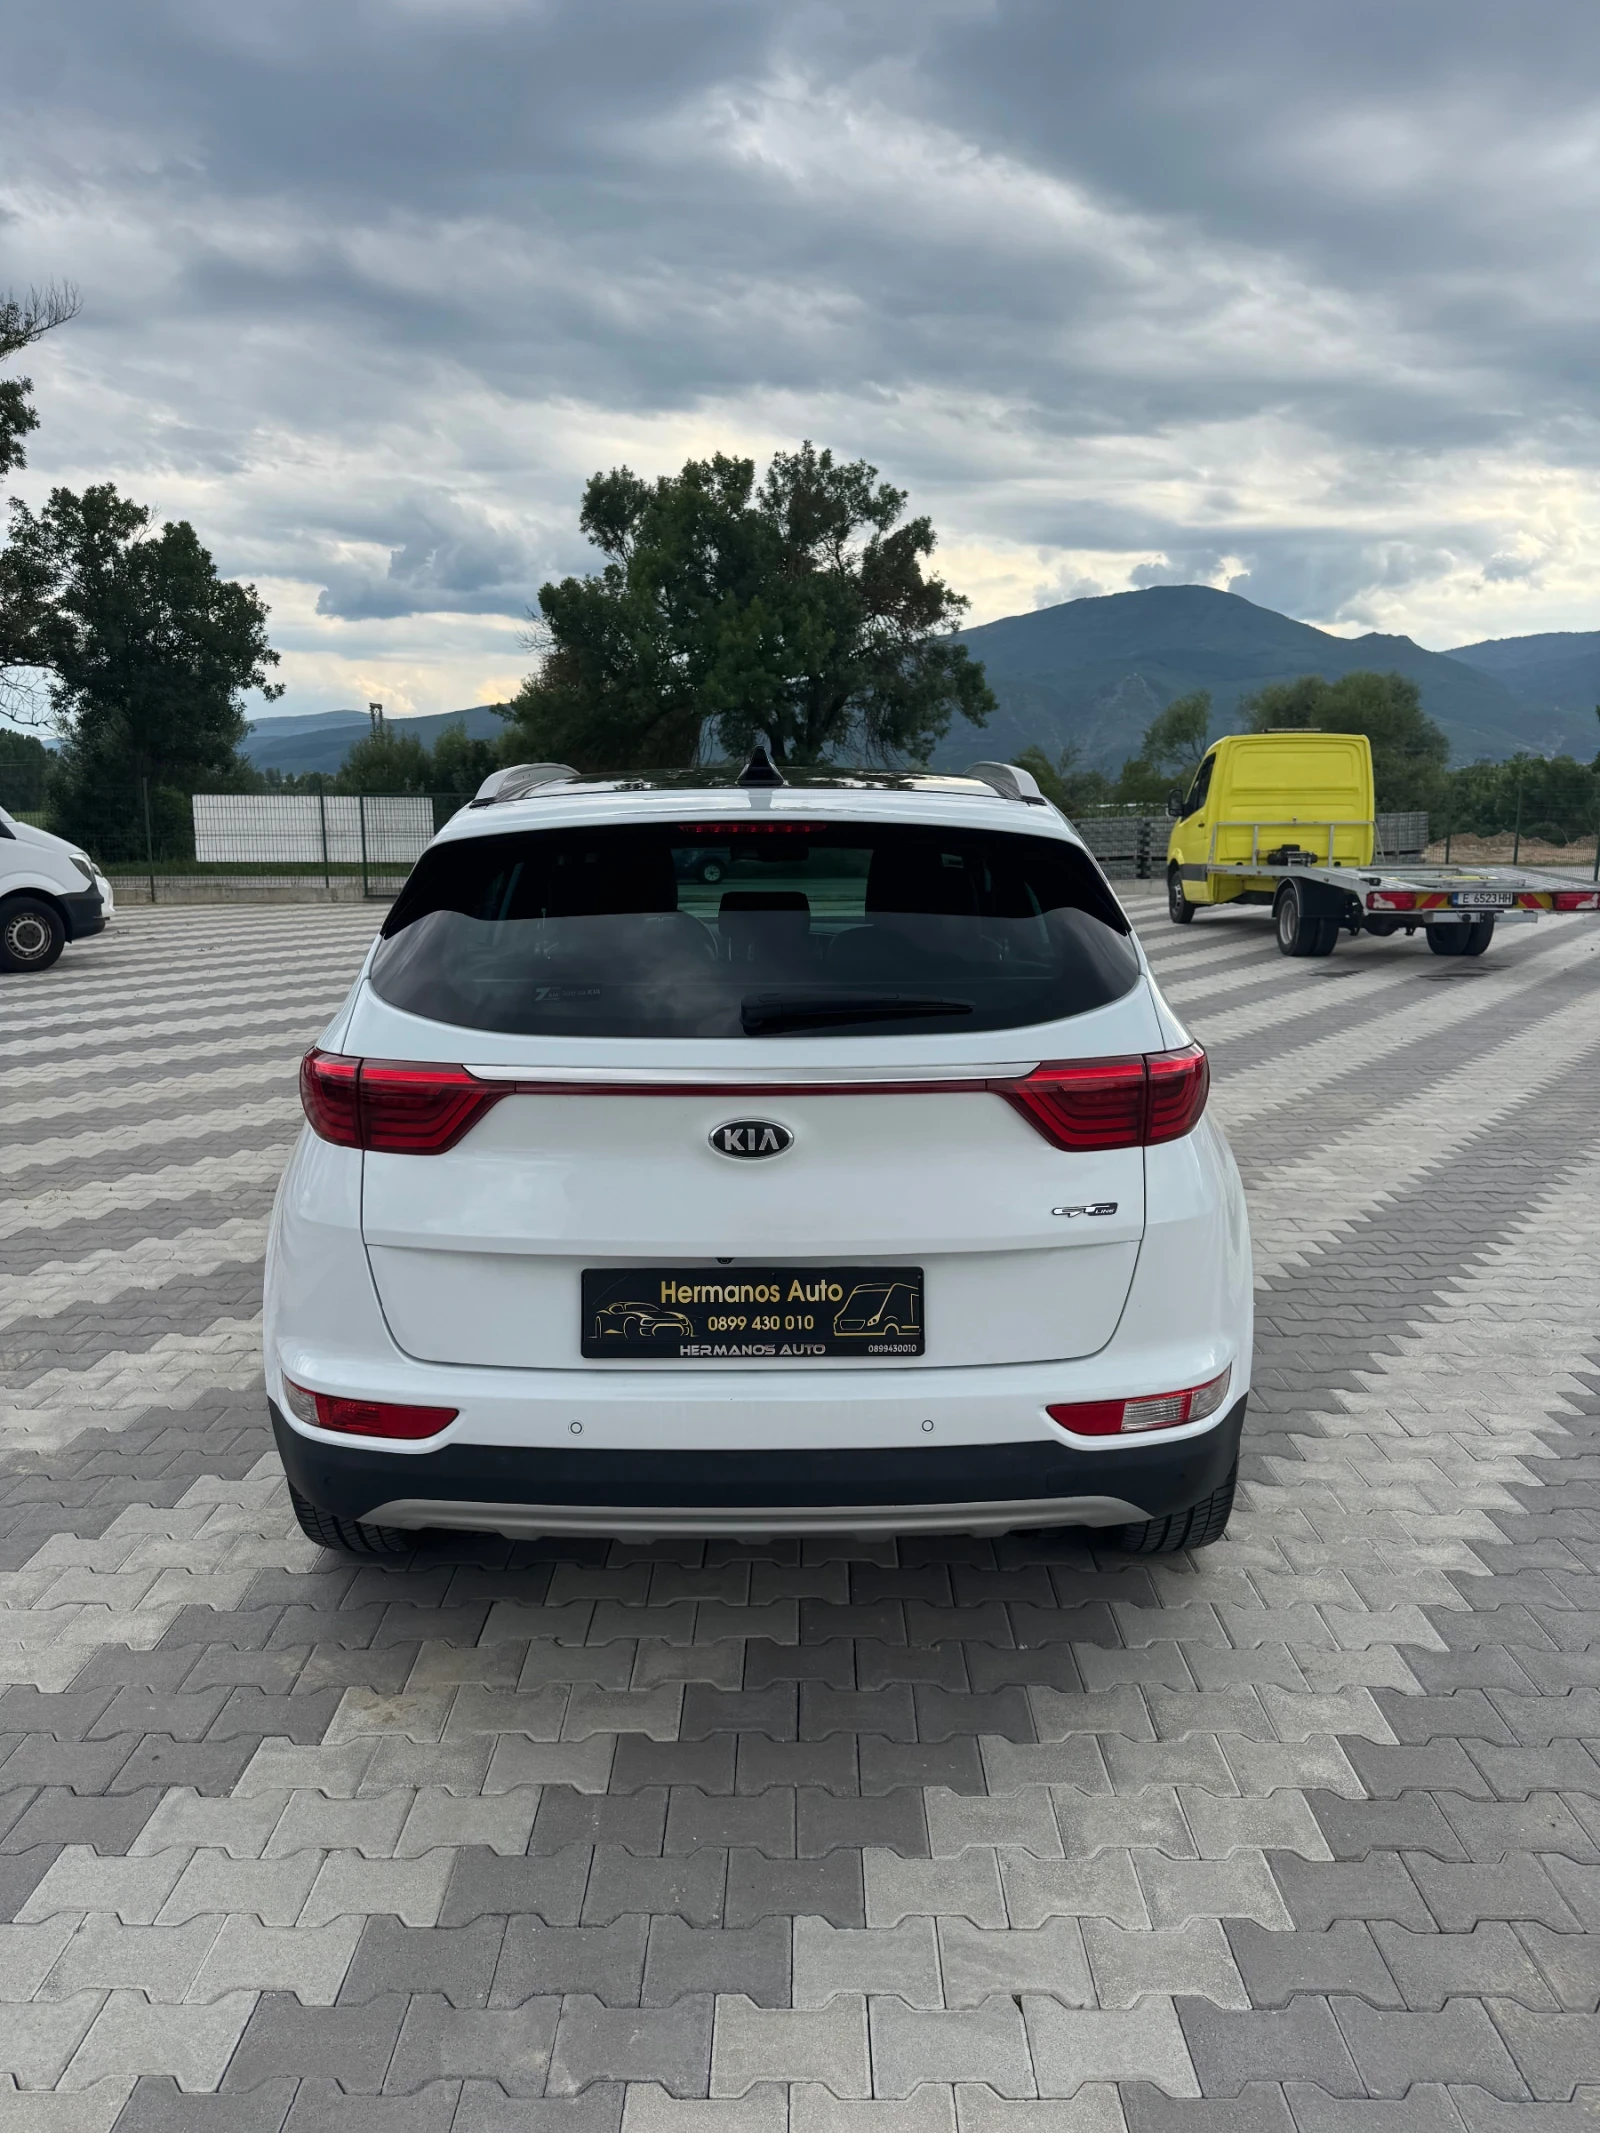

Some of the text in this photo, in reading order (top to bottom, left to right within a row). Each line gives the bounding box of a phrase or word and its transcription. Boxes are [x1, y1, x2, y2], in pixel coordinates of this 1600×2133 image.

[1463, 894, 1470, 903] E
[723, 1129, 780, 1150] KIA
[660, 1279, 844, 1303] Hermanos Auto
[707, 1315, 814, 1332] 0899 430 010
[679, 1343, 826, 1356] HERMANOS AUTO
[868, 1344, 917, 1353] 0899430010
